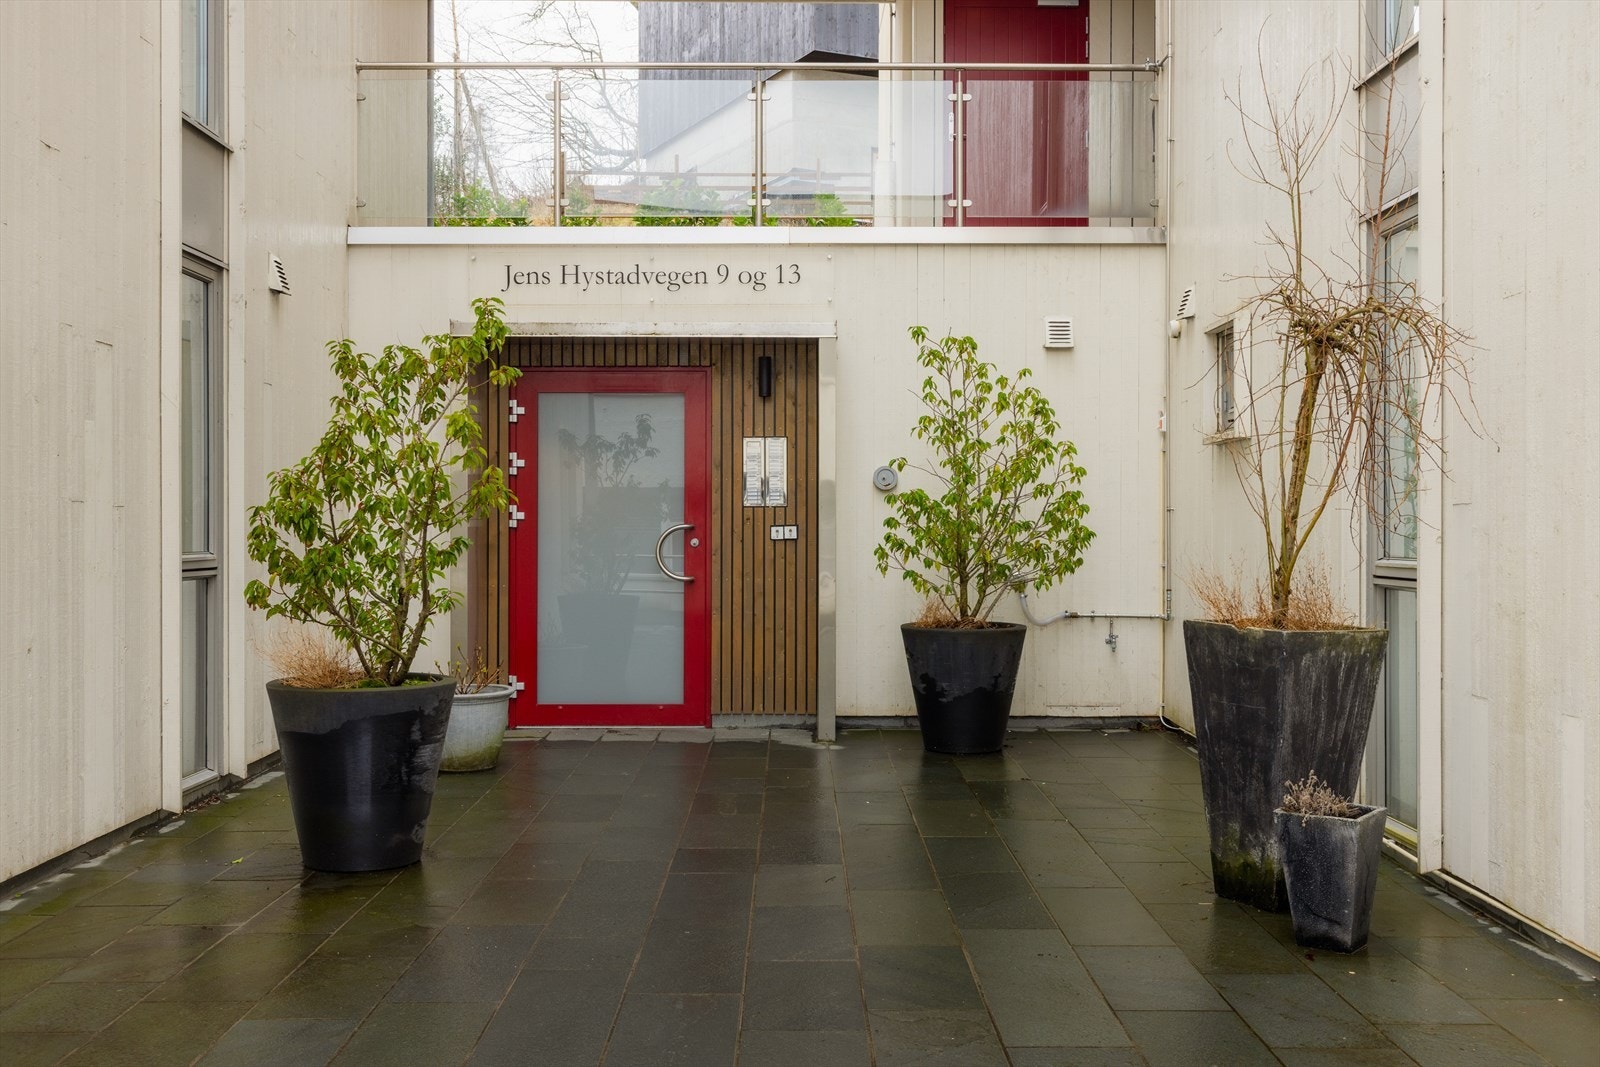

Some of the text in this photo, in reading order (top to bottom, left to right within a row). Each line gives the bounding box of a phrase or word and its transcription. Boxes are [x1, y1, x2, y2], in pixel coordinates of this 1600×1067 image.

[501, 264, 801, 292] Jens Hystadvegen 9 og 13
